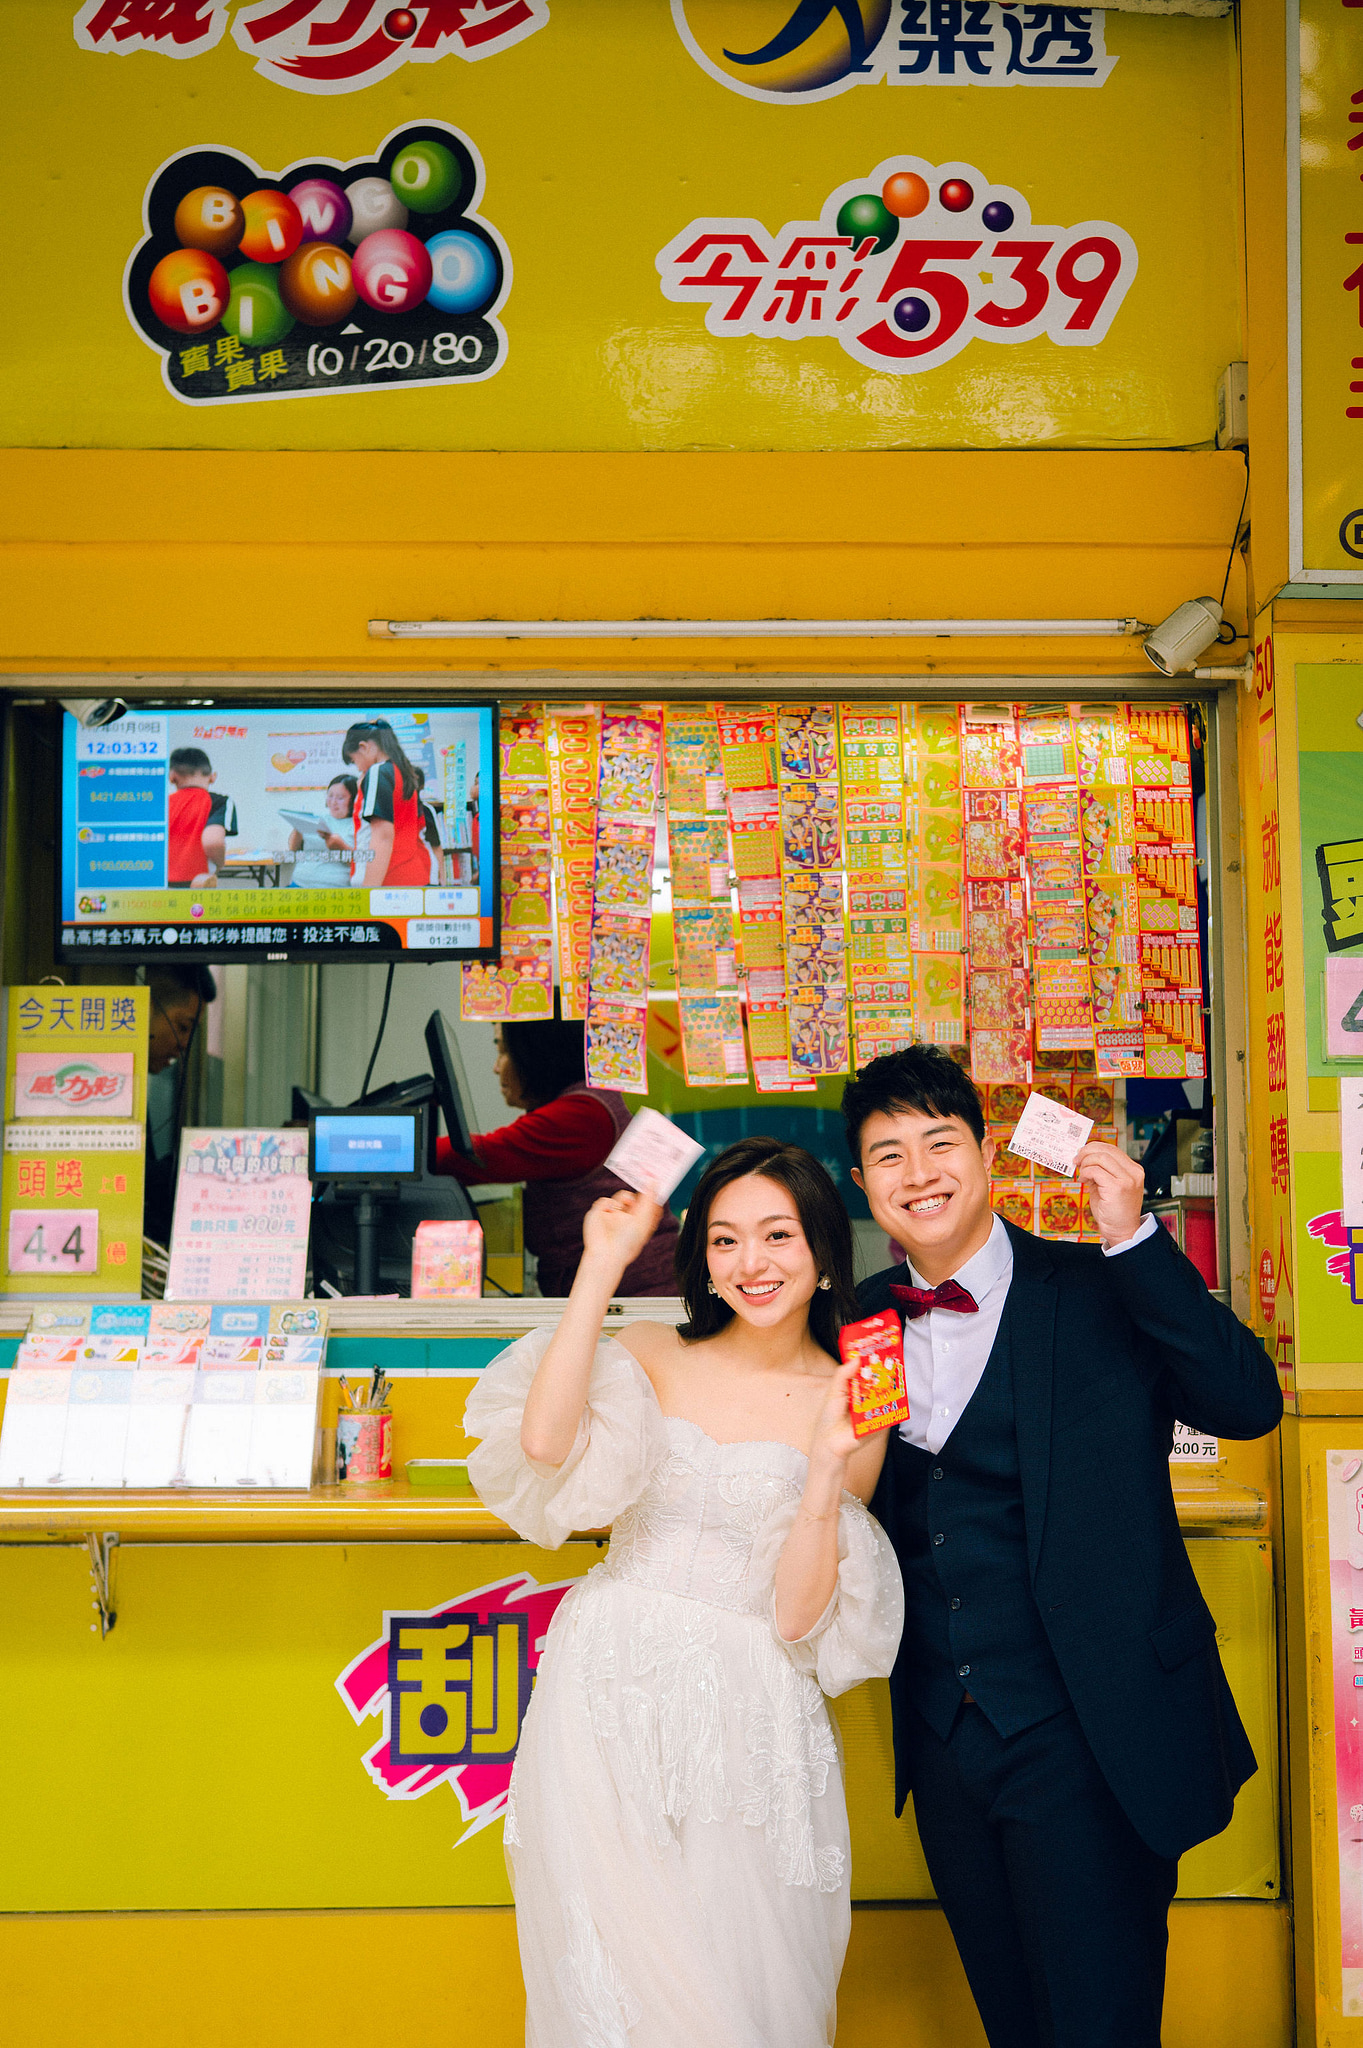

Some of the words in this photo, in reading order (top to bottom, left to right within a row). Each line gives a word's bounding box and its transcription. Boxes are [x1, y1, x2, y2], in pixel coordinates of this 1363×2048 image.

[201, 156, 431, 252] BINGO
[179, 247, 473, 338] BINGO
[673, 233, 1122, 358] 今彩539
[179, 335, 244, 377] 賓果
[224, 349, 289, 392] 賓果
[307, 332, 483, 376] 10/20/80
[86, 741, 159, 755] 12:03:32
[429, 936, 458, 945] 01:28
[19, 997, 136, 1032] 今天開獎
[29, 1074, 119, 1102] 威力彩
[18, 1159, 84, 1199] 頭獎
[98, 1174, 127, 1195] 上看
[23, 1224, 85, 1264] 4.4
[242, 1215, 283, 1235] 300
[106, 1241, 127, 1265] 億
[1202, 1442, 1216, 1456] 元
